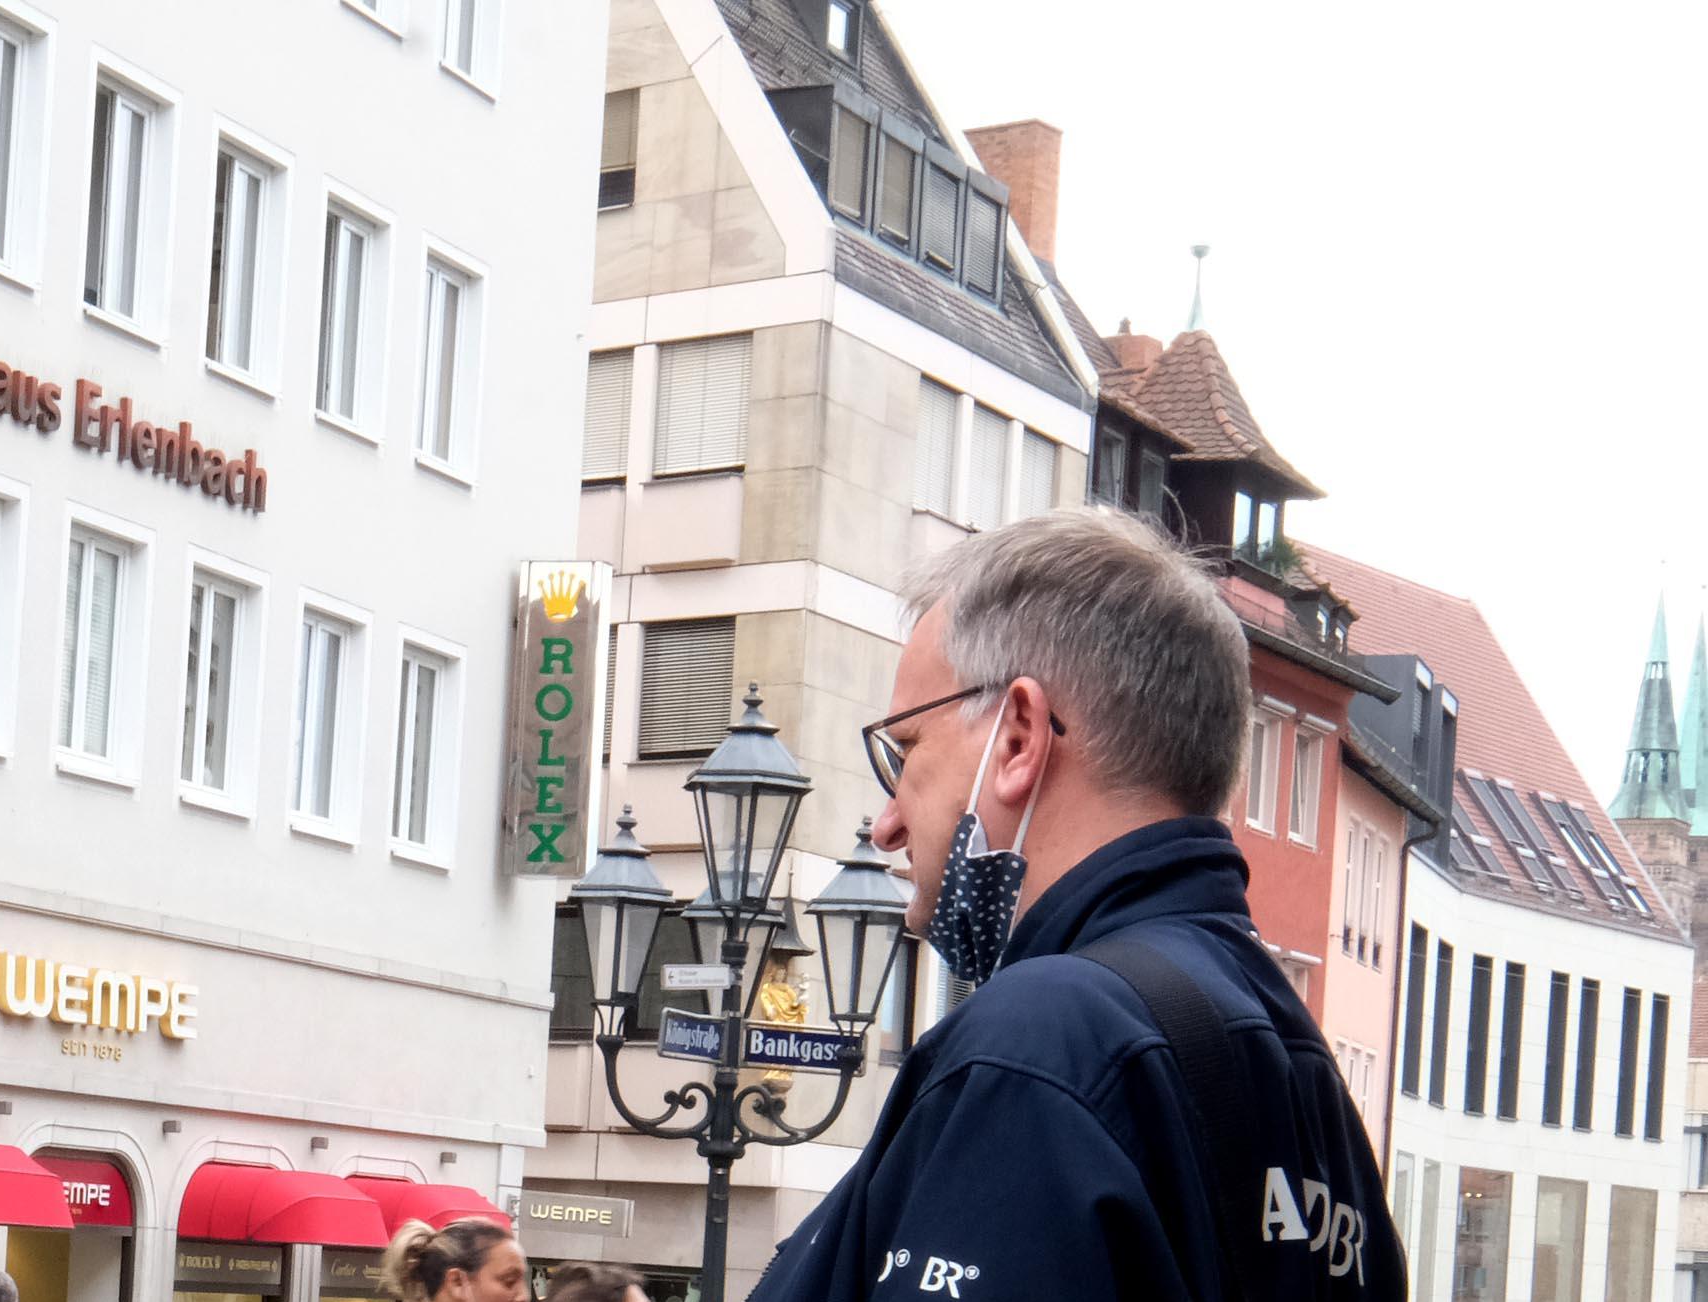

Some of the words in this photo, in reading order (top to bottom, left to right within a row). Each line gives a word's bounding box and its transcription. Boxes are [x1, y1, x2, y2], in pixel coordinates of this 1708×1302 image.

[73, 378, 269, 513] Erlenbach
[526, 637, 574, 863] ROLEX
[530, 1204, 612, 1225] WEMPE
